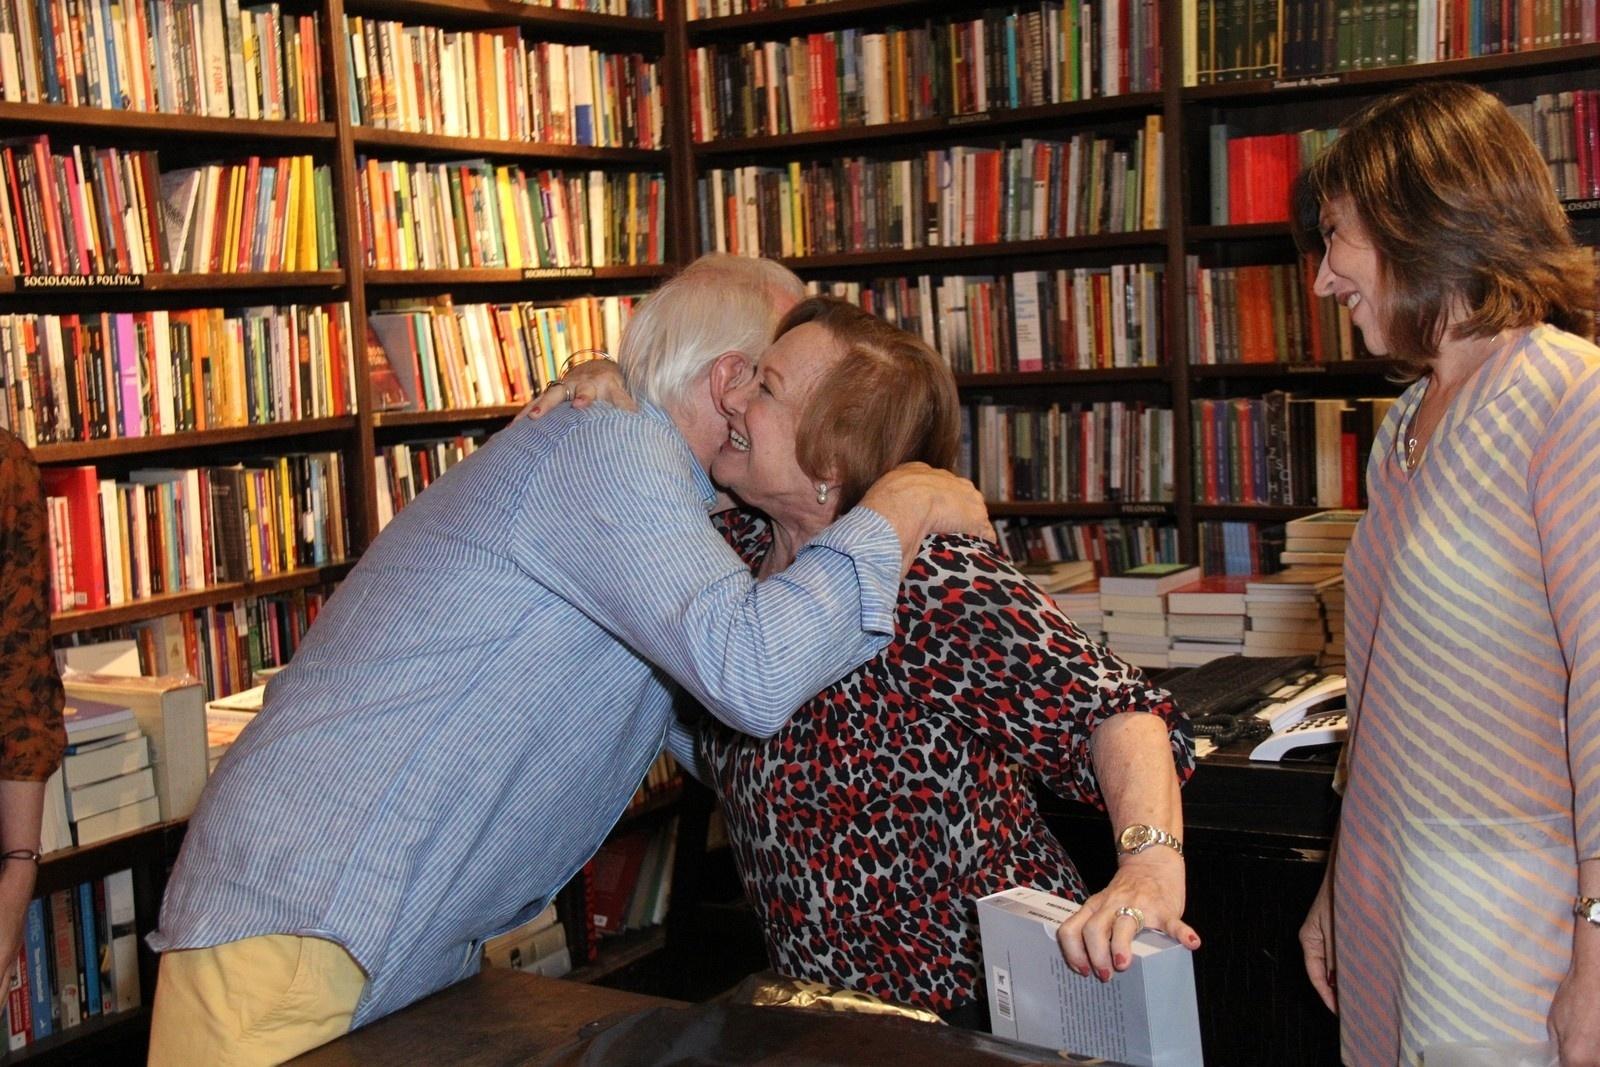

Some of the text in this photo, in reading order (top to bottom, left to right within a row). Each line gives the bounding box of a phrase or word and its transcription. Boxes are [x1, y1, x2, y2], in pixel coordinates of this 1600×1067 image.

[24, 273, 141, 287] SOCIOLOGIA E POLÍTICA
